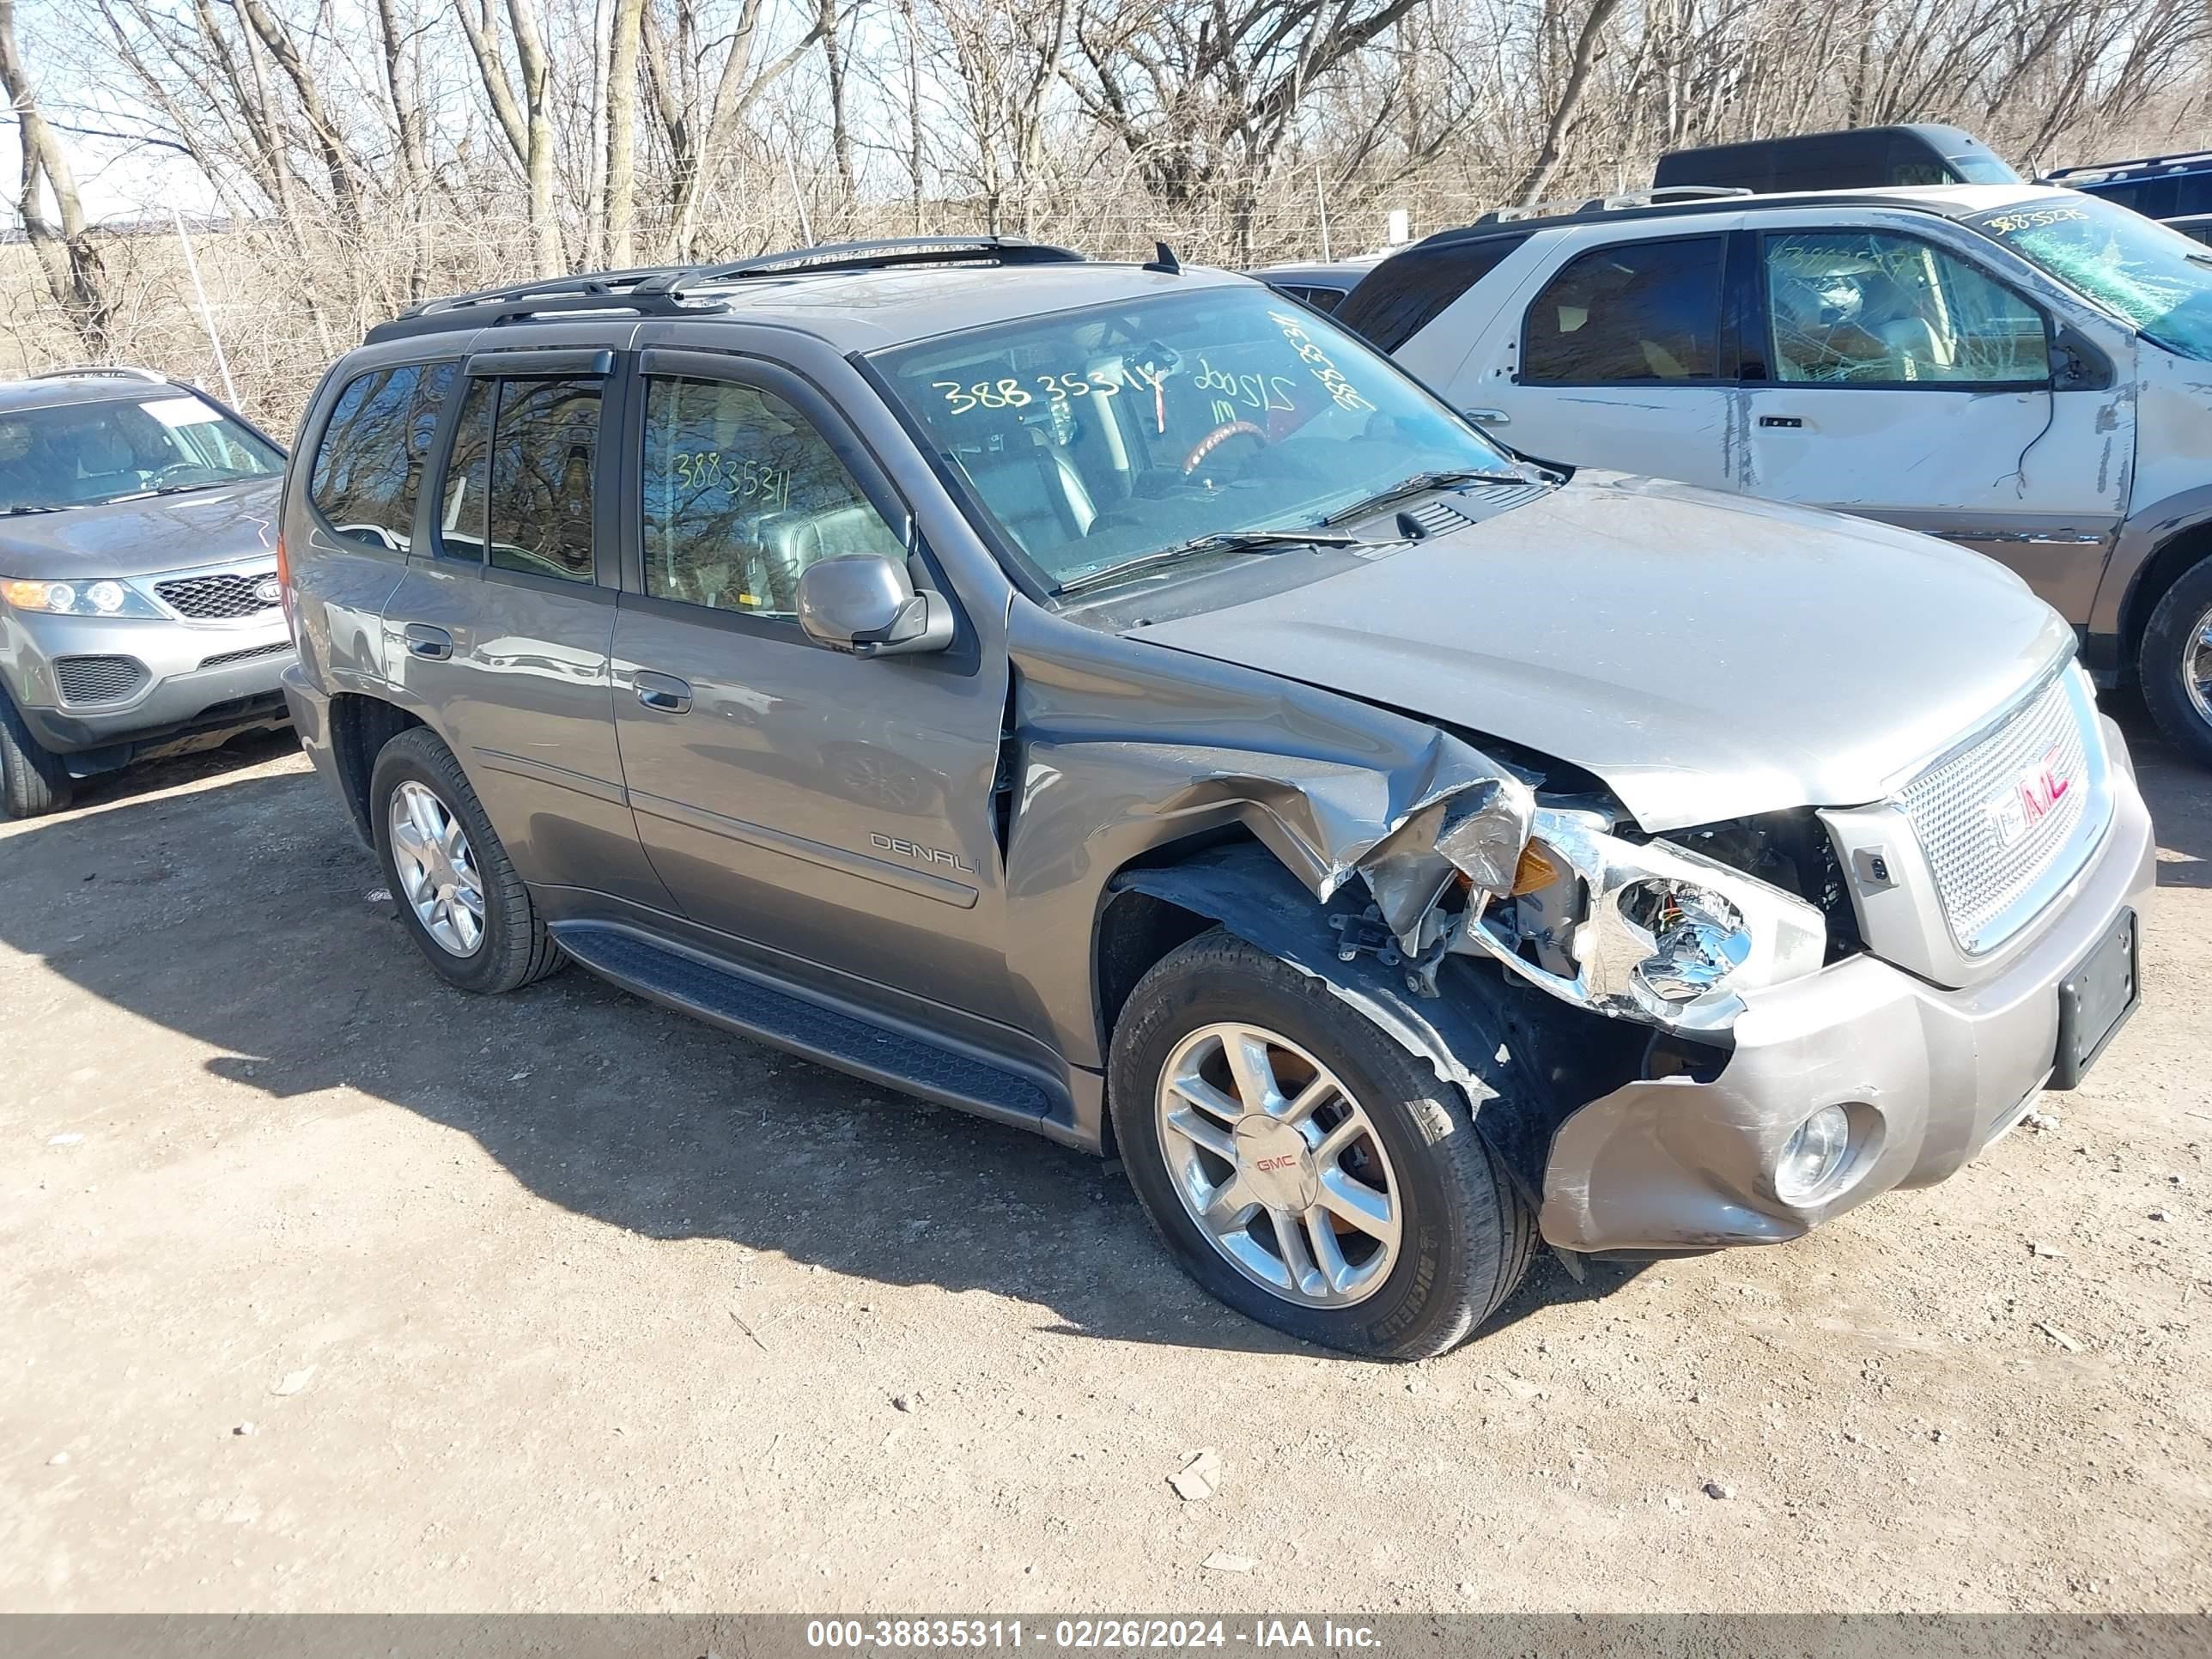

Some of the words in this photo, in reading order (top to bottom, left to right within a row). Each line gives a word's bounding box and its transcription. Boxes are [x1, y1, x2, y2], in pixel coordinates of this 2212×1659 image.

[1981, 209, 2090, 236] 38835275
[672, 452, 791, 512] 38835311
[869, 831, 981, 875] DENALI
[1256, 1154, 1297, 1172] GMC
